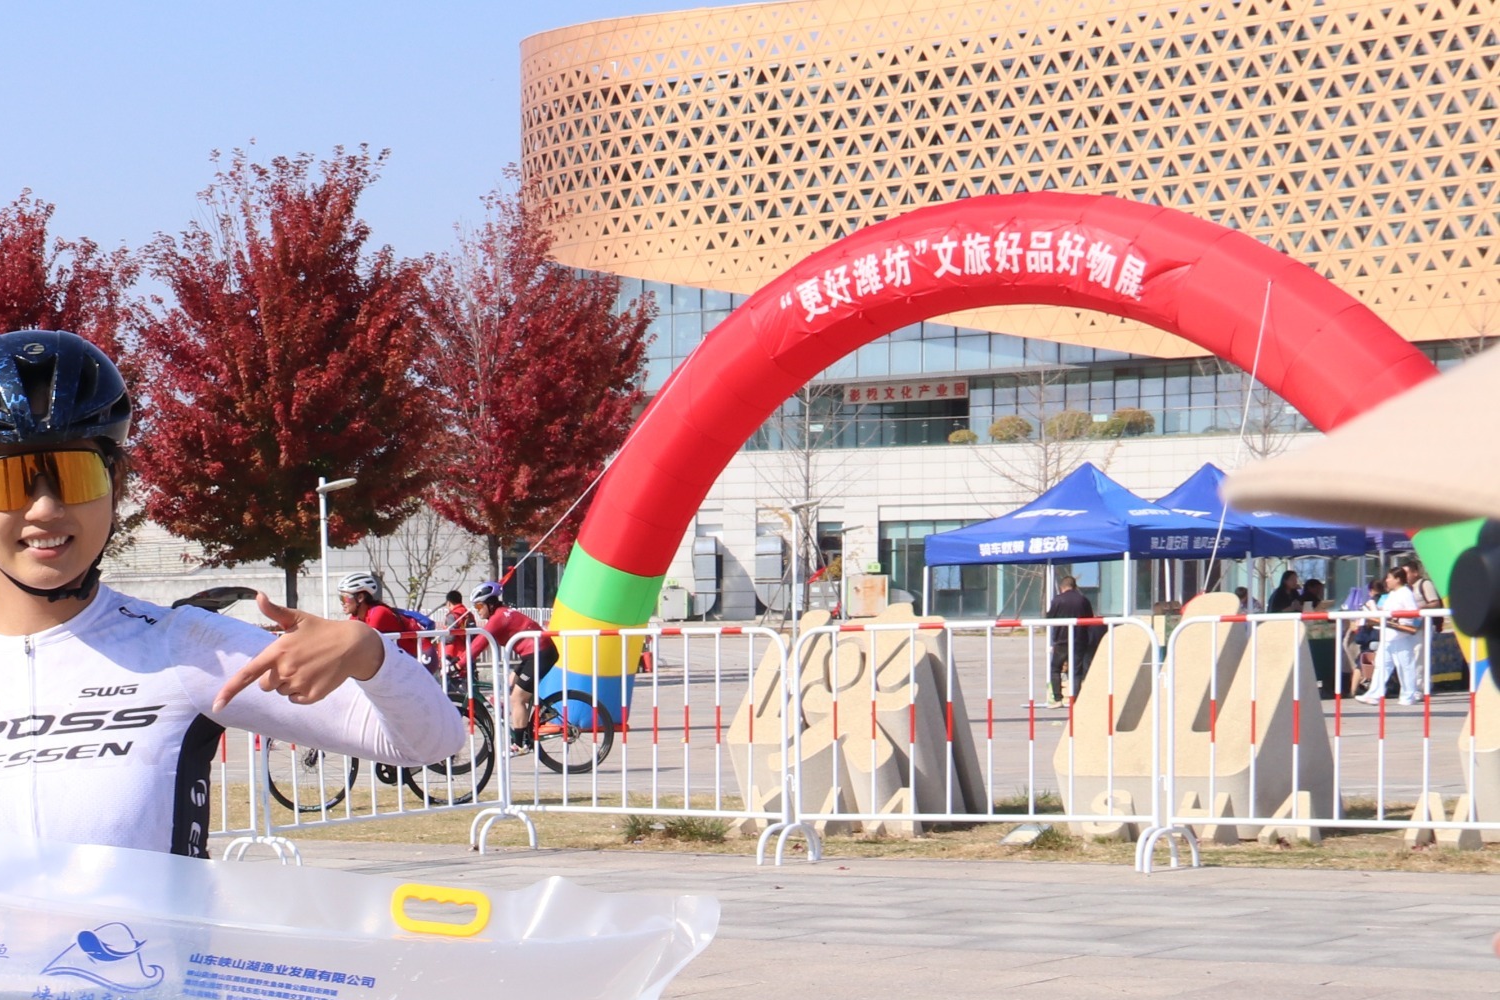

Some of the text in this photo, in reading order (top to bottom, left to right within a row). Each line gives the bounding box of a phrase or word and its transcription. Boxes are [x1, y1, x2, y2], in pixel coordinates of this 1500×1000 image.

[849, 382, 966, 402] 影视文化产业园
[78, 683, 140, 699] SWG
[189, 952, 376, 988] 山东峡山湖渔业发展有限公司
